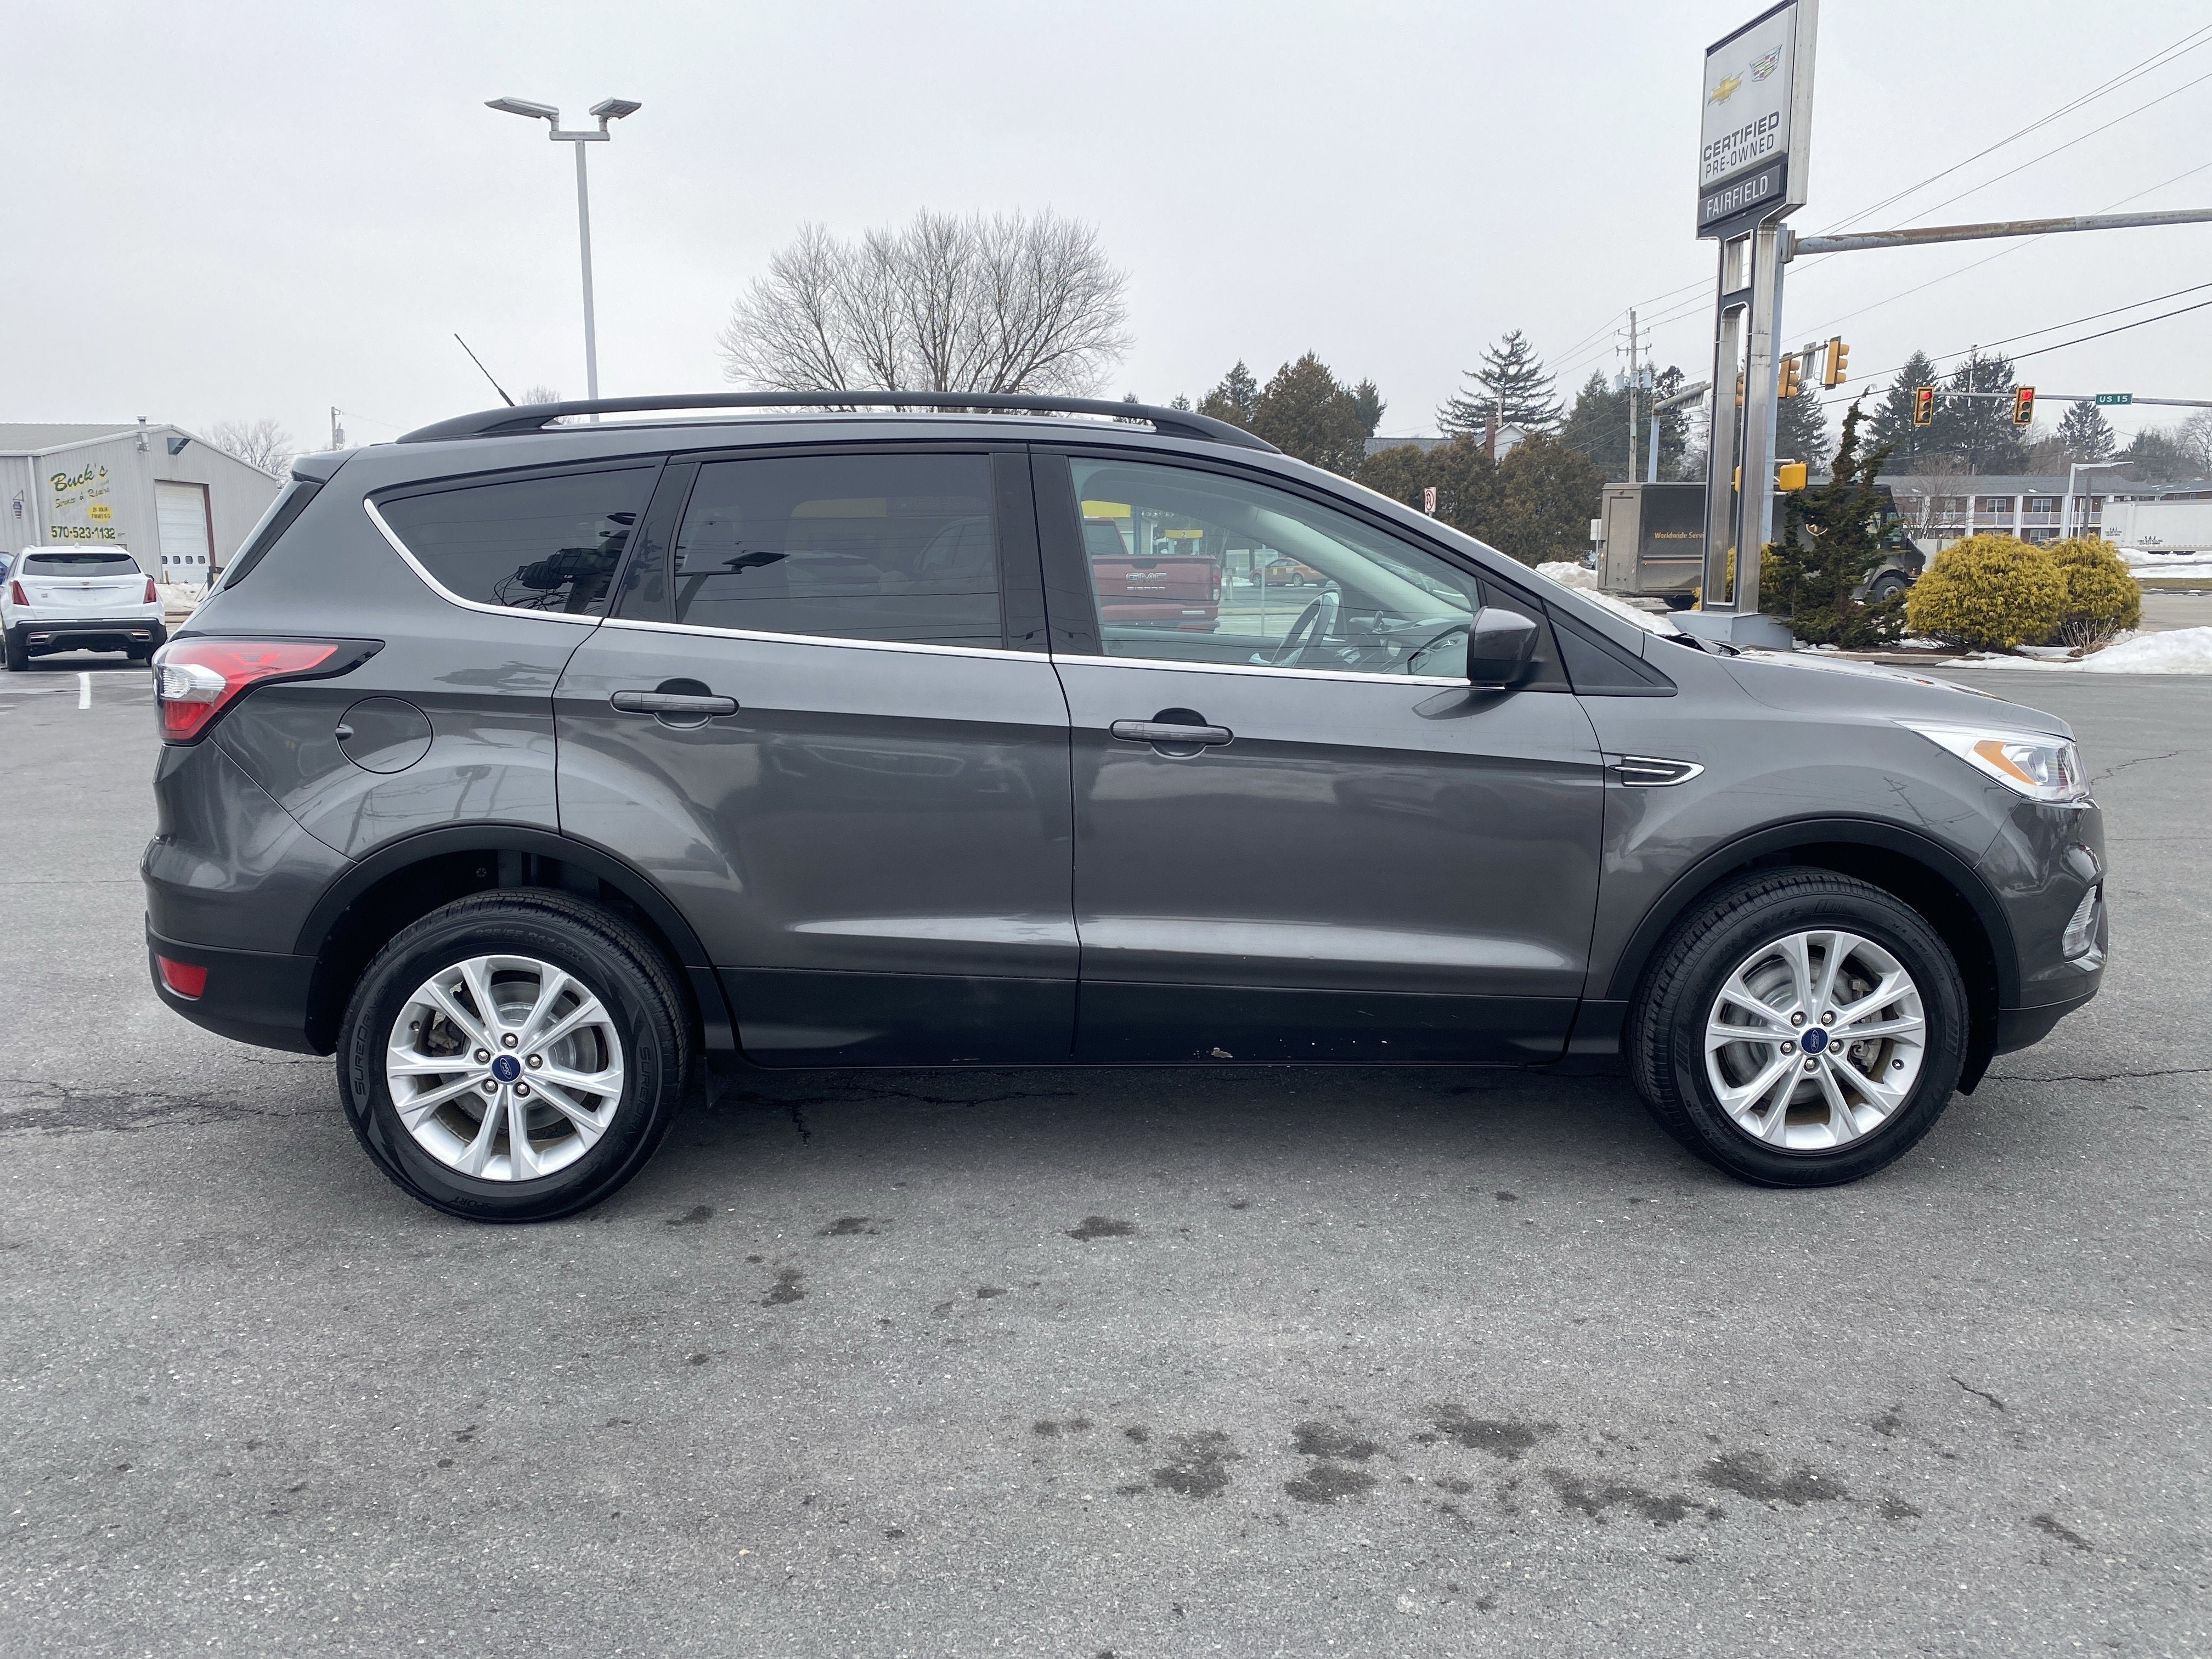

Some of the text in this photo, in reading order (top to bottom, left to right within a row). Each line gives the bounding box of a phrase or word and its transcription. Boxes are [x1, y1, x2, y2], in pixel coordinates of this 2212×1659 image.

[1703, 111, 1780, 162] CERTIFIED
[1706, 133, 1774, 179] PRE-OWNED
[1706, 175, 1769, 219] FAIRFIELD
[50, 462, 108, 492] Buck's
[1126, 572, 1167, 582] GMC
[448, 1195, 493, 1210] SPORT
